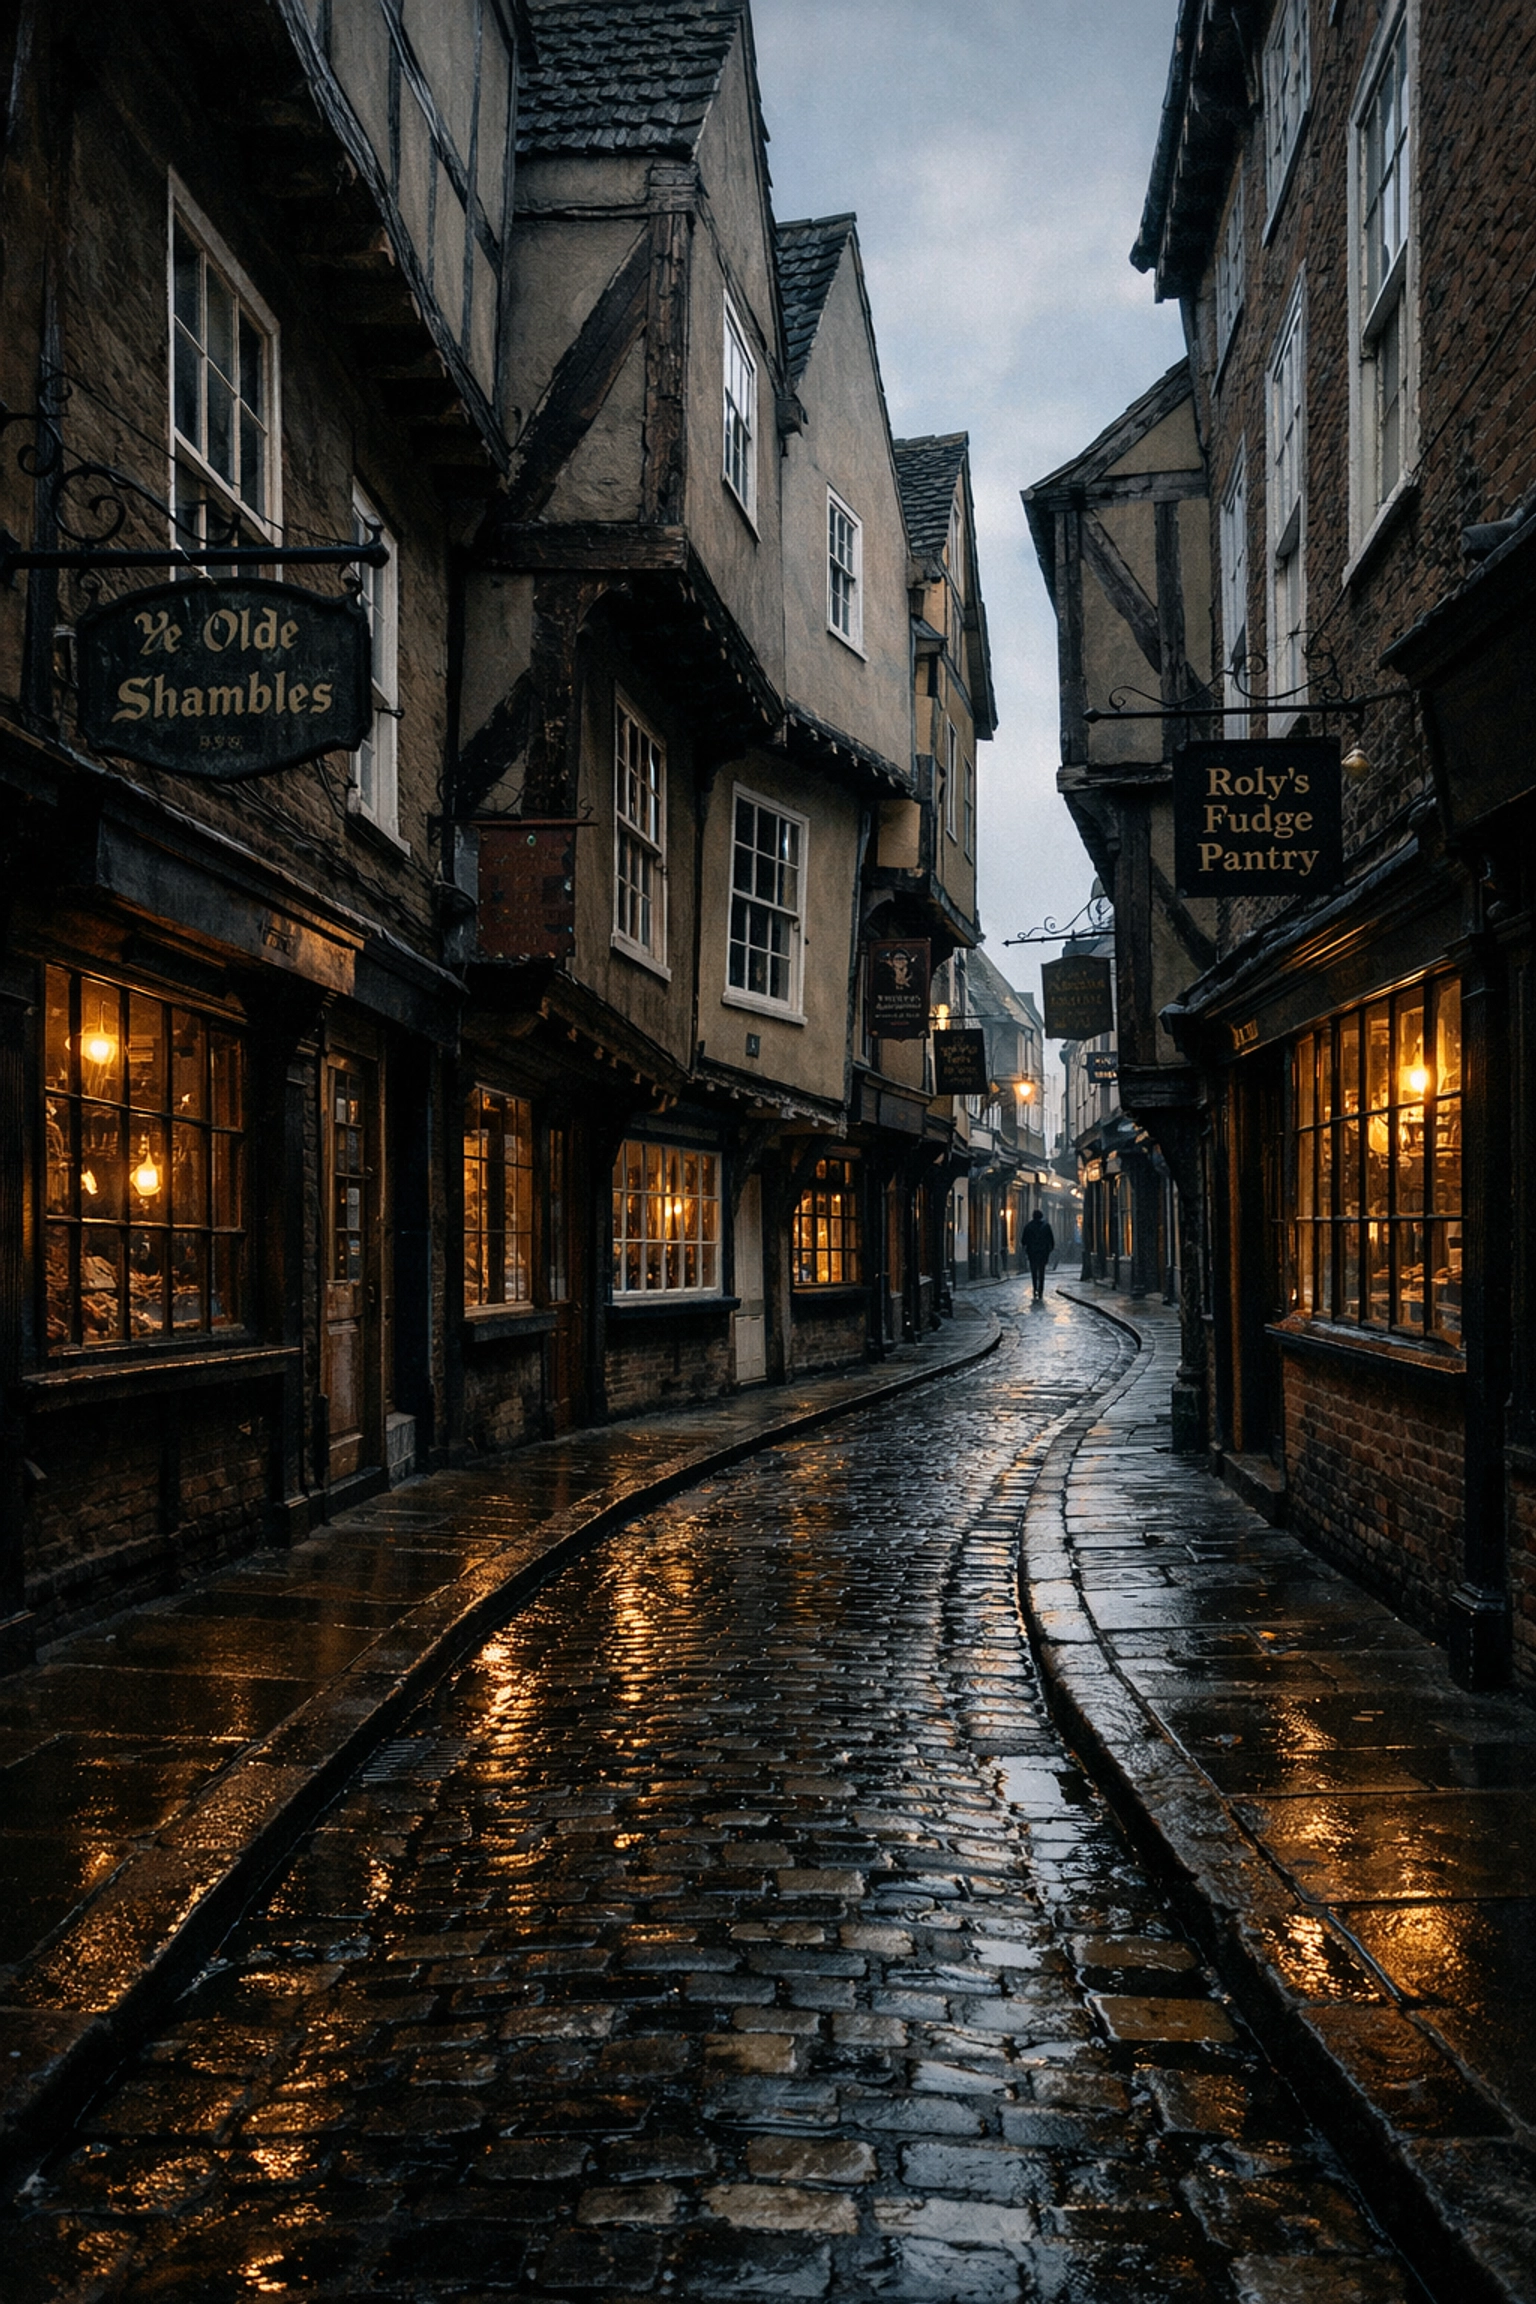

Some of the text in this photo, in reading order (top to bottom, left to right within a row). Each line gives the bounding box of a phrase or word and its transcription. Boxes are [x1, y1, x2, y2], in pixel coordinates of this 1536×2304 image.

[134, 607, 300, 656] Ye Olde
[111, 671, 334, 722] Shambles
[1206, 766, 1310, 801] Roly's
[1203, 803, 1313, 839] Fudge
[1197, 842, 1320, 877] Pantry
